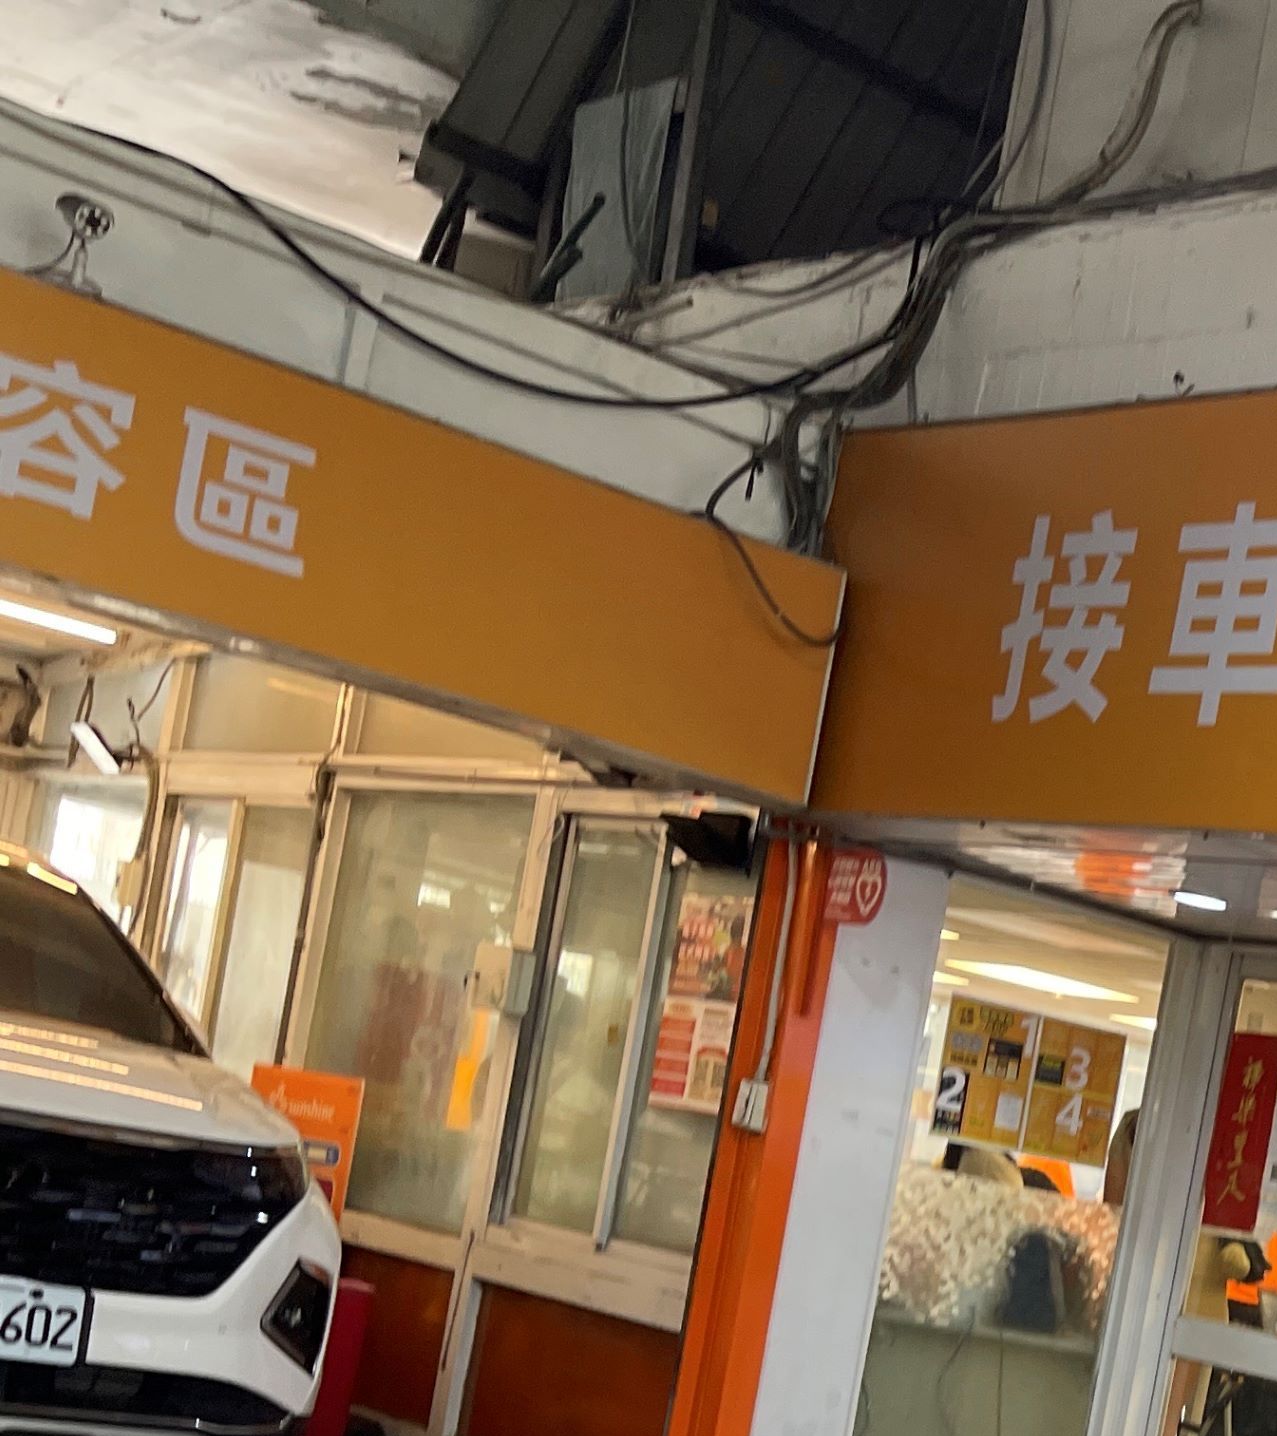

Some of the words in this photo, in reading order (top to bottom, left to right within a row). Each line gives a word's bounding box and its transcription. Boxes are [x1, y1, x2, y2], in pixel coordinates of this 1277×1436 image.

[0, 361, 316, 578] 容區
[937, 1066, 966, 1112] 2
[1065, 1047, 1091, 1090] 3
[1055, 1093, 1082, 1136] 4
[0, 1299, 78, 1351] 602
